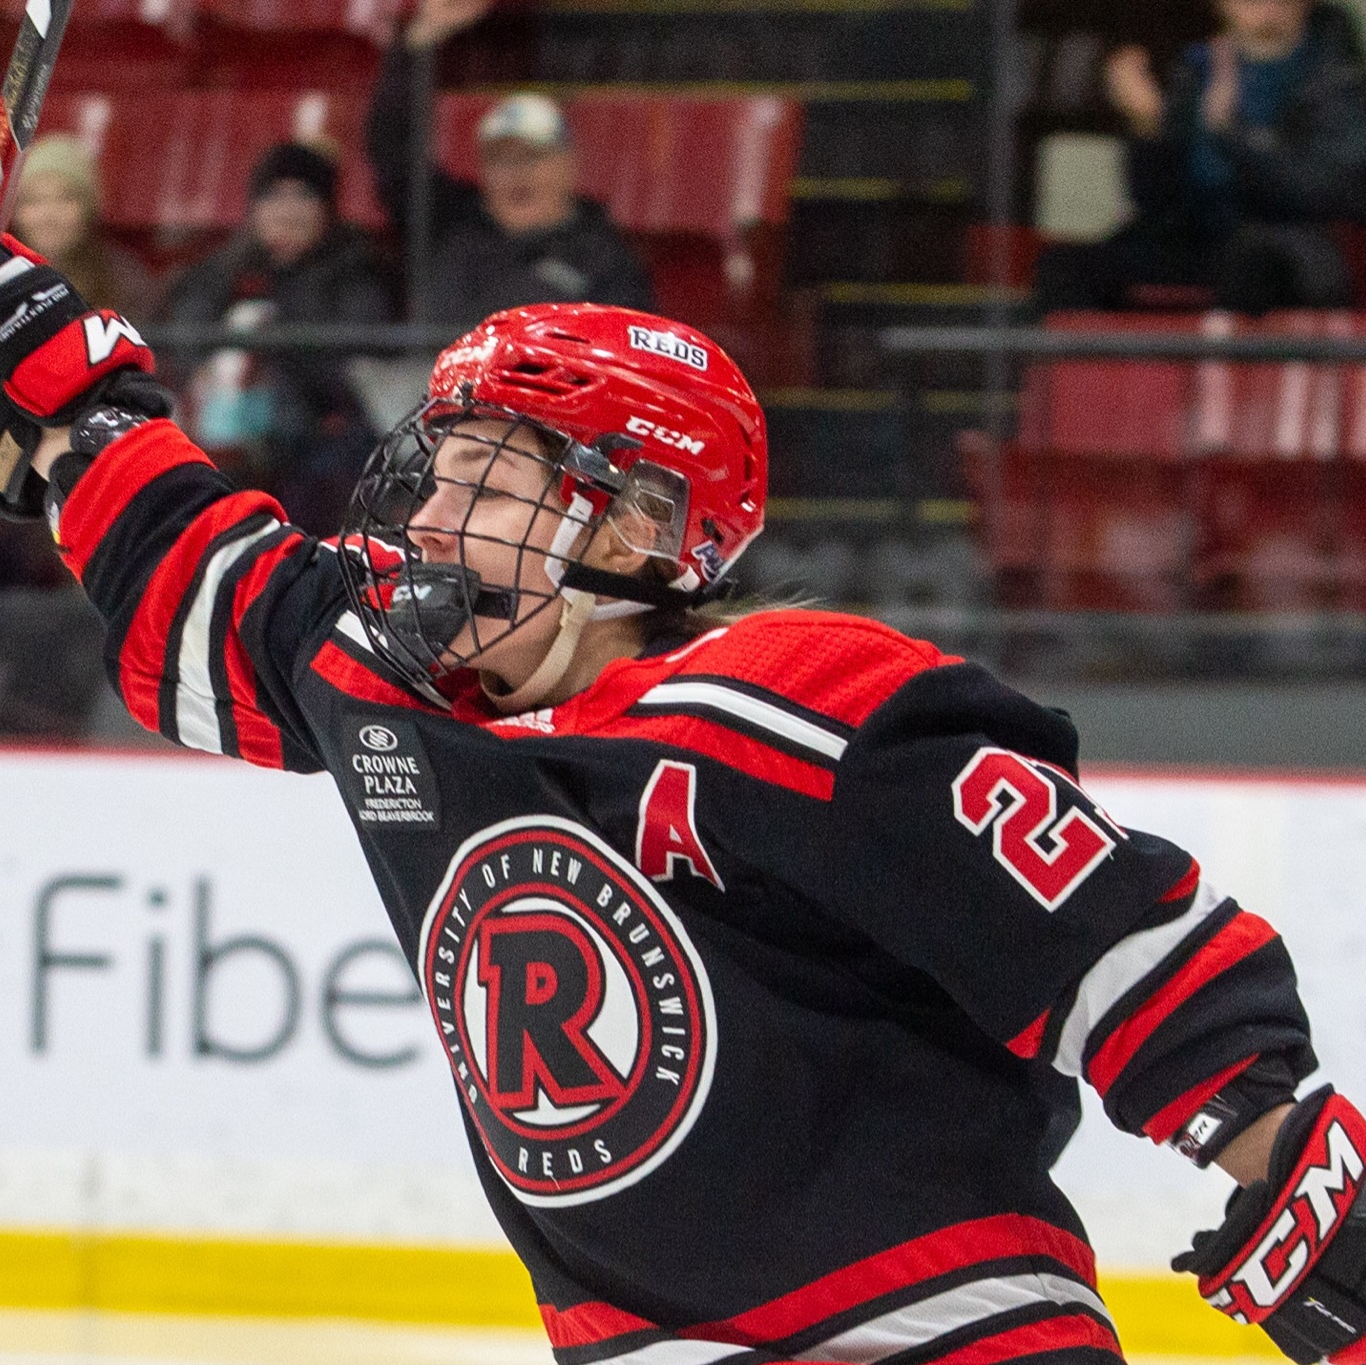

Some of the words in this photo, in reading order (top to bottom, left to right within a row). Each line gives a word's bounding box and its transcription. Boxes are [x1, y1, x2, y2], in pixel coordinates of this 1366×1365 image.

[631, 328, 706, 370] REDS
[626, 414, 705, 455] CCM
[352, 754, 420, 774] CROWNE
[364, 775, 417, 794] PLAZA
[636, 759, 725, 894] A
[951, 746, 1129, 913] 2
[482, 855, 510, 888] OF
[533, 847, 582, 885] NEW
[596, 883, 686, 1086] BRUNSWICK
[478, 912, 632, 1108] R
[518, 1139, 612, 1176] REDS
